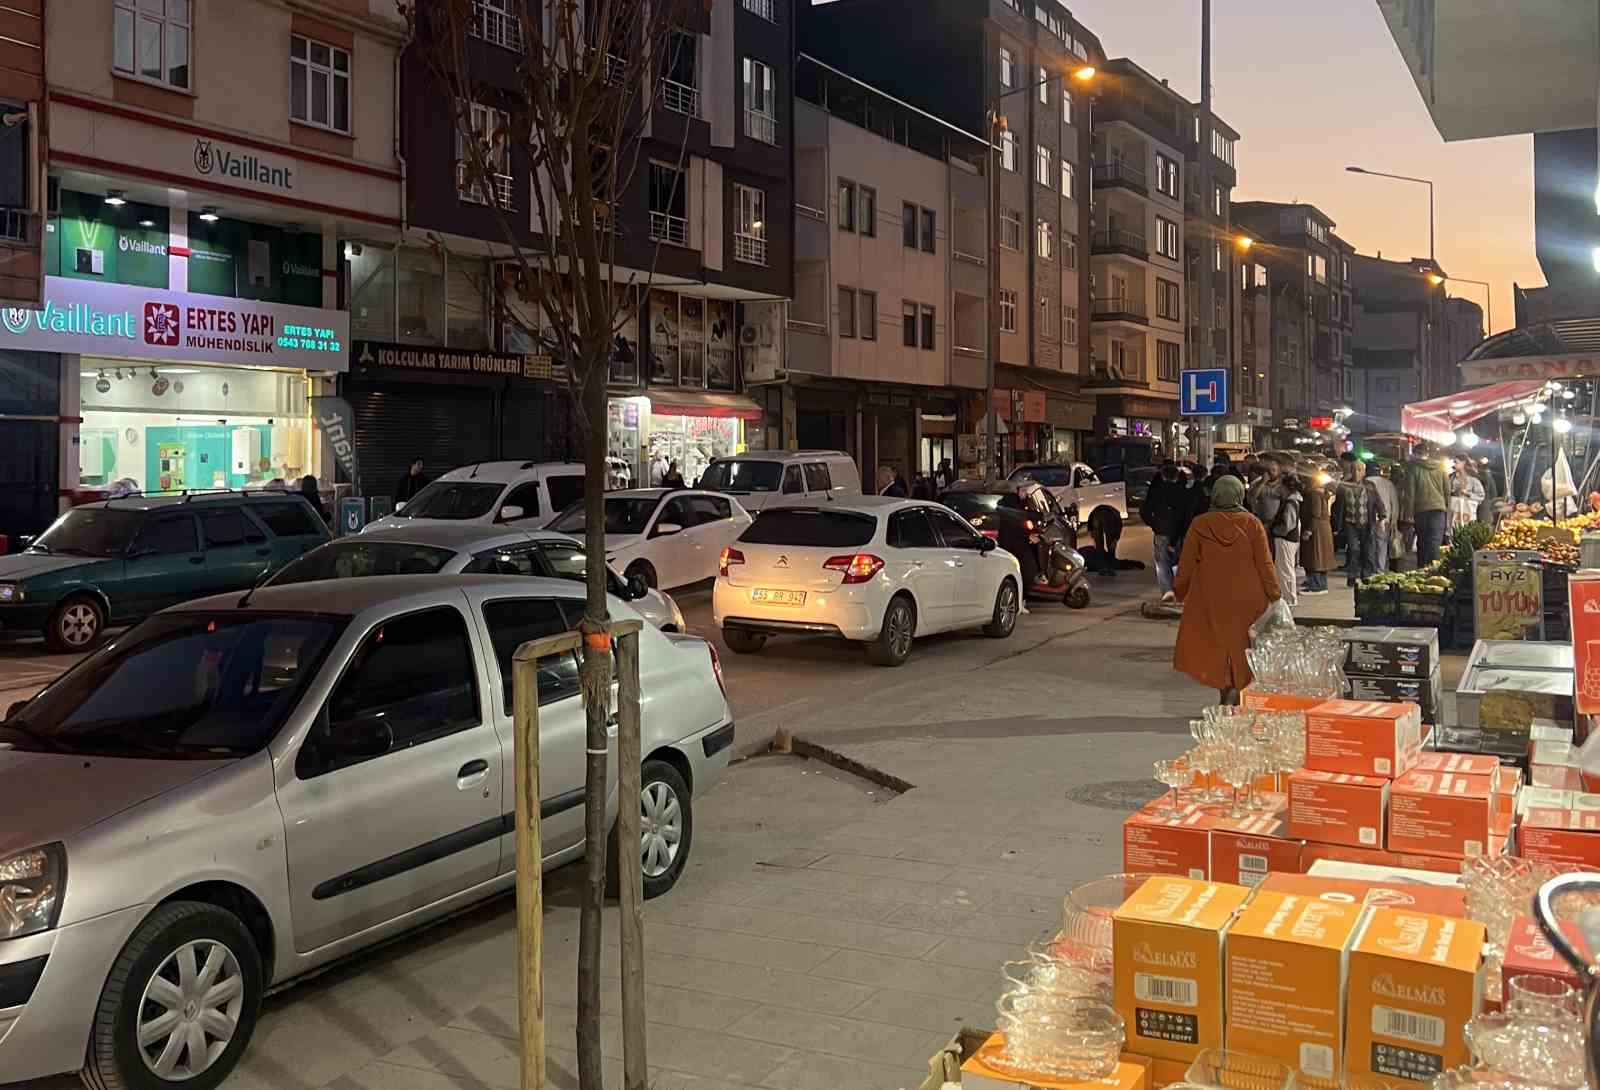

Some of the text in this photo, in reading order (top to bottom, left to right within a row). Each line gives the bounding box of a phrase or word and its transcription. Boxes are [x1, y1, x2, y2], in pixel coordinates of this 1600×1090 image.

[216, 149, 292, 189] Vaillant
[129, 239, 166, 256] Vaillant
[36, 301, 136, 338] Vaillant
[187, 307, 274, 336] ERTES YAPI
[378, 349, 435, 367] KOLCULAR
[438, 354, 470, 370] TARIM
